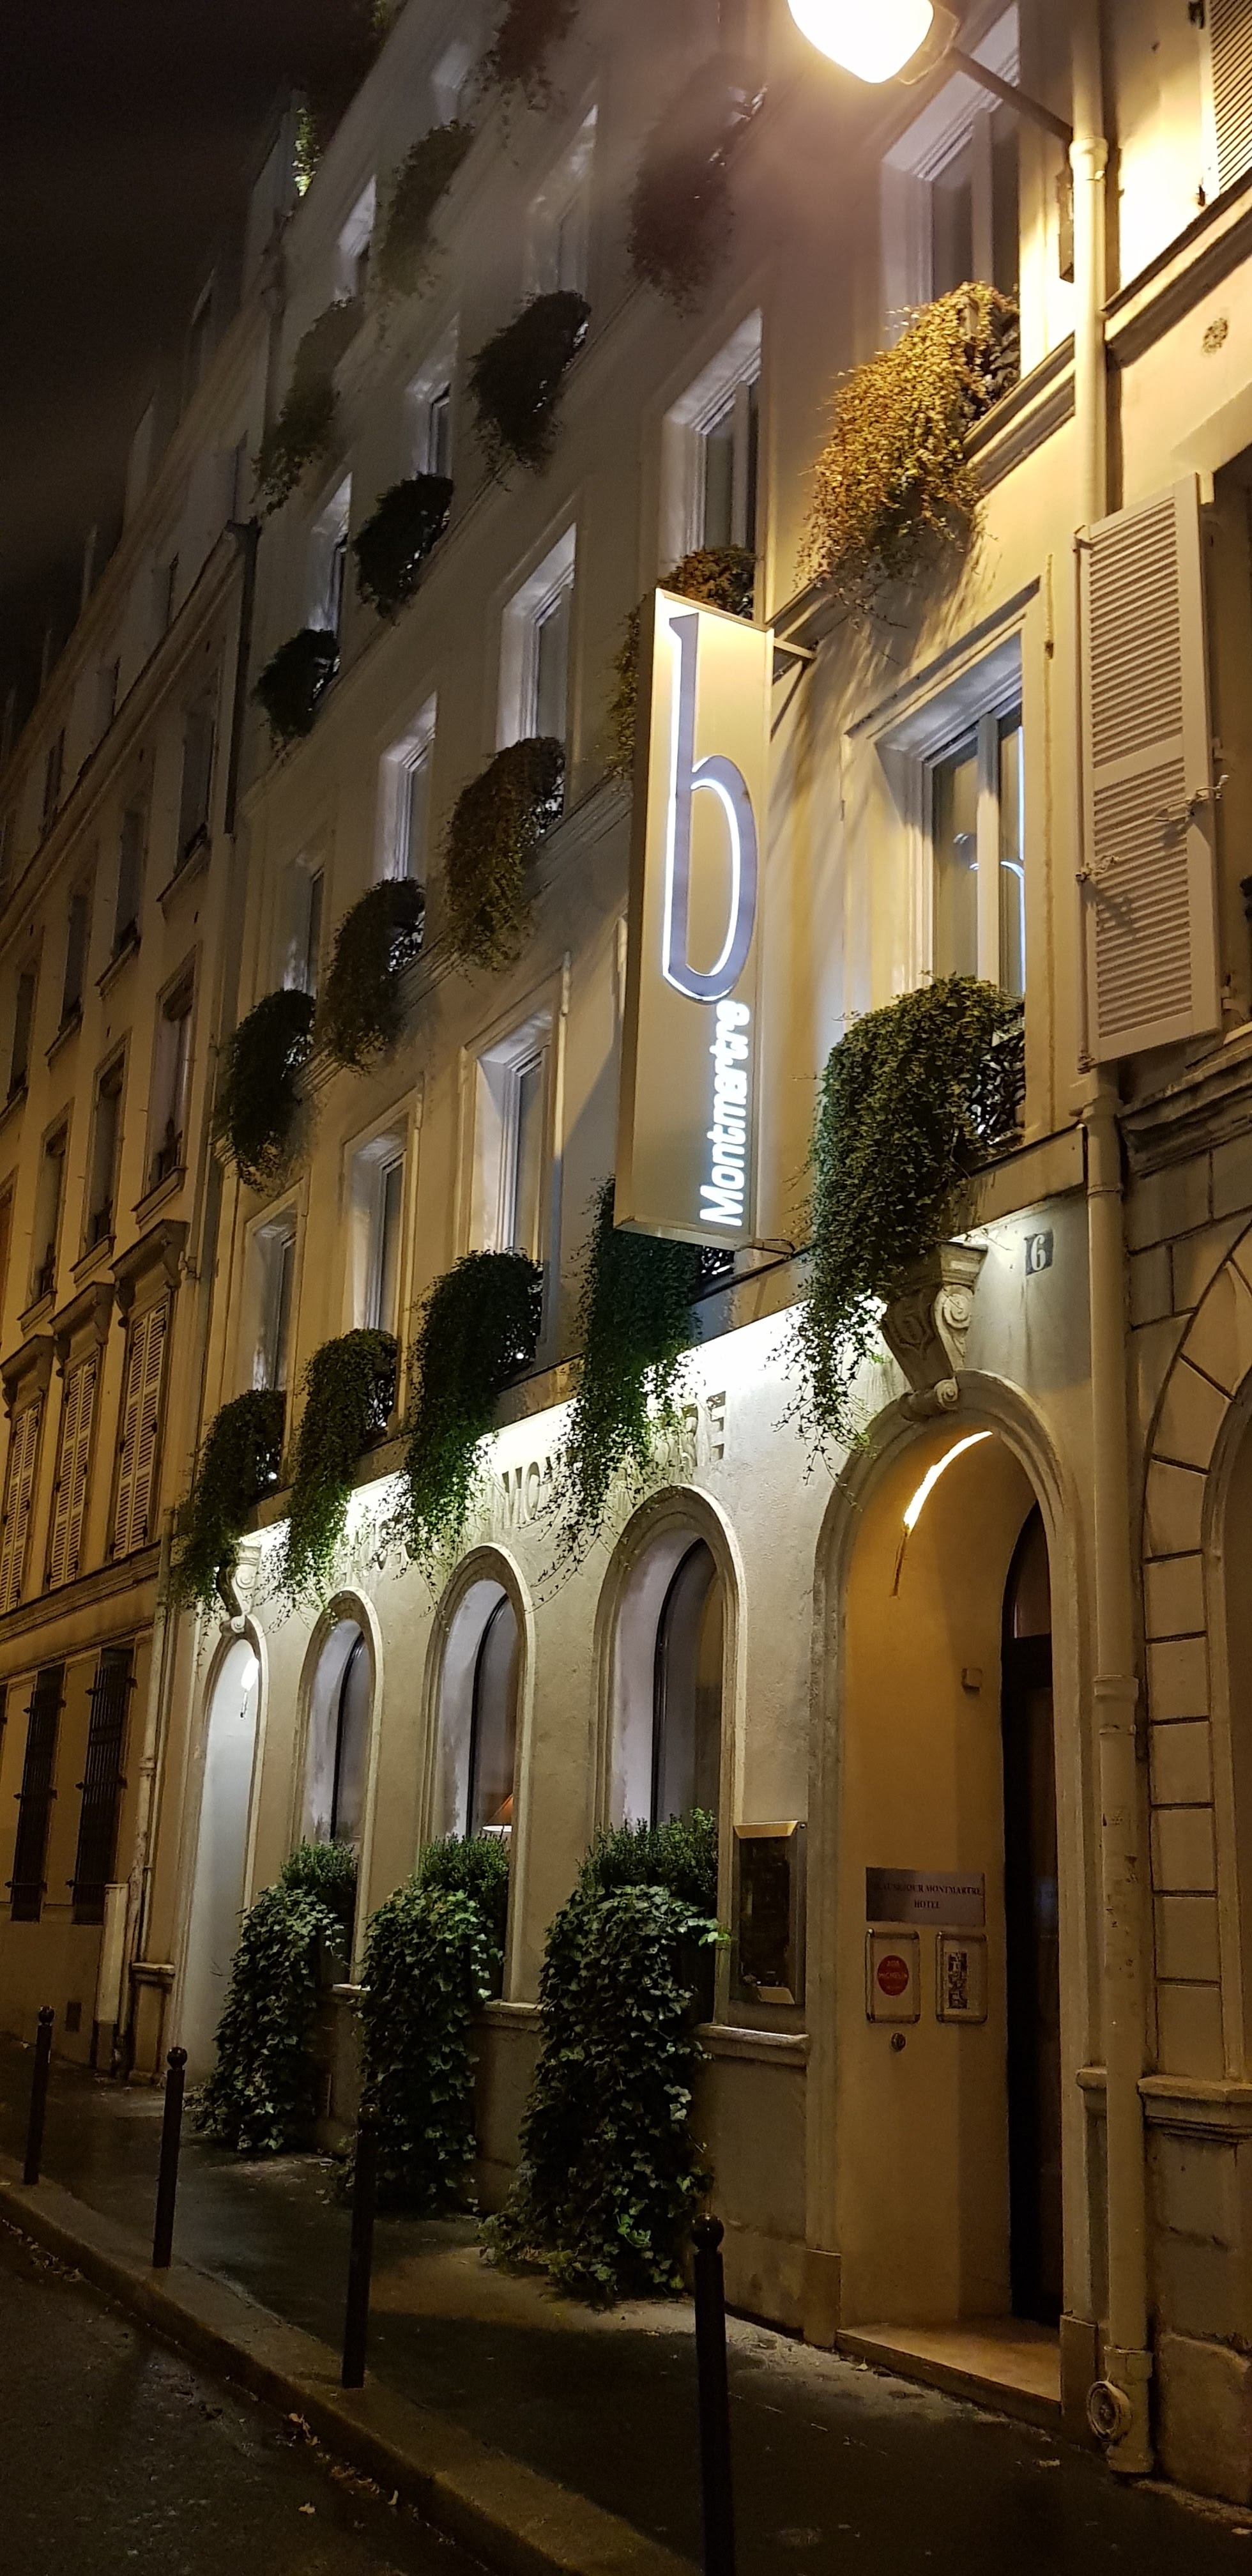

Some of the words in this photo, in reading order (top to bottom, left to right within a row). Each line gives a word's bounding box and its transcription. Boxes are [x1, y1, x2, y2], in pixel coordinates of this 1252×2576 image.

[662, 611, 759, 1004] b
[699, 1000, 751, 1227] Montmartre
[1030, 1234, 1046, 1271] 6
[913, 1899, 940, 1910] HOTEL
[926, 1884, 982, 1896] MONTMARTRE
